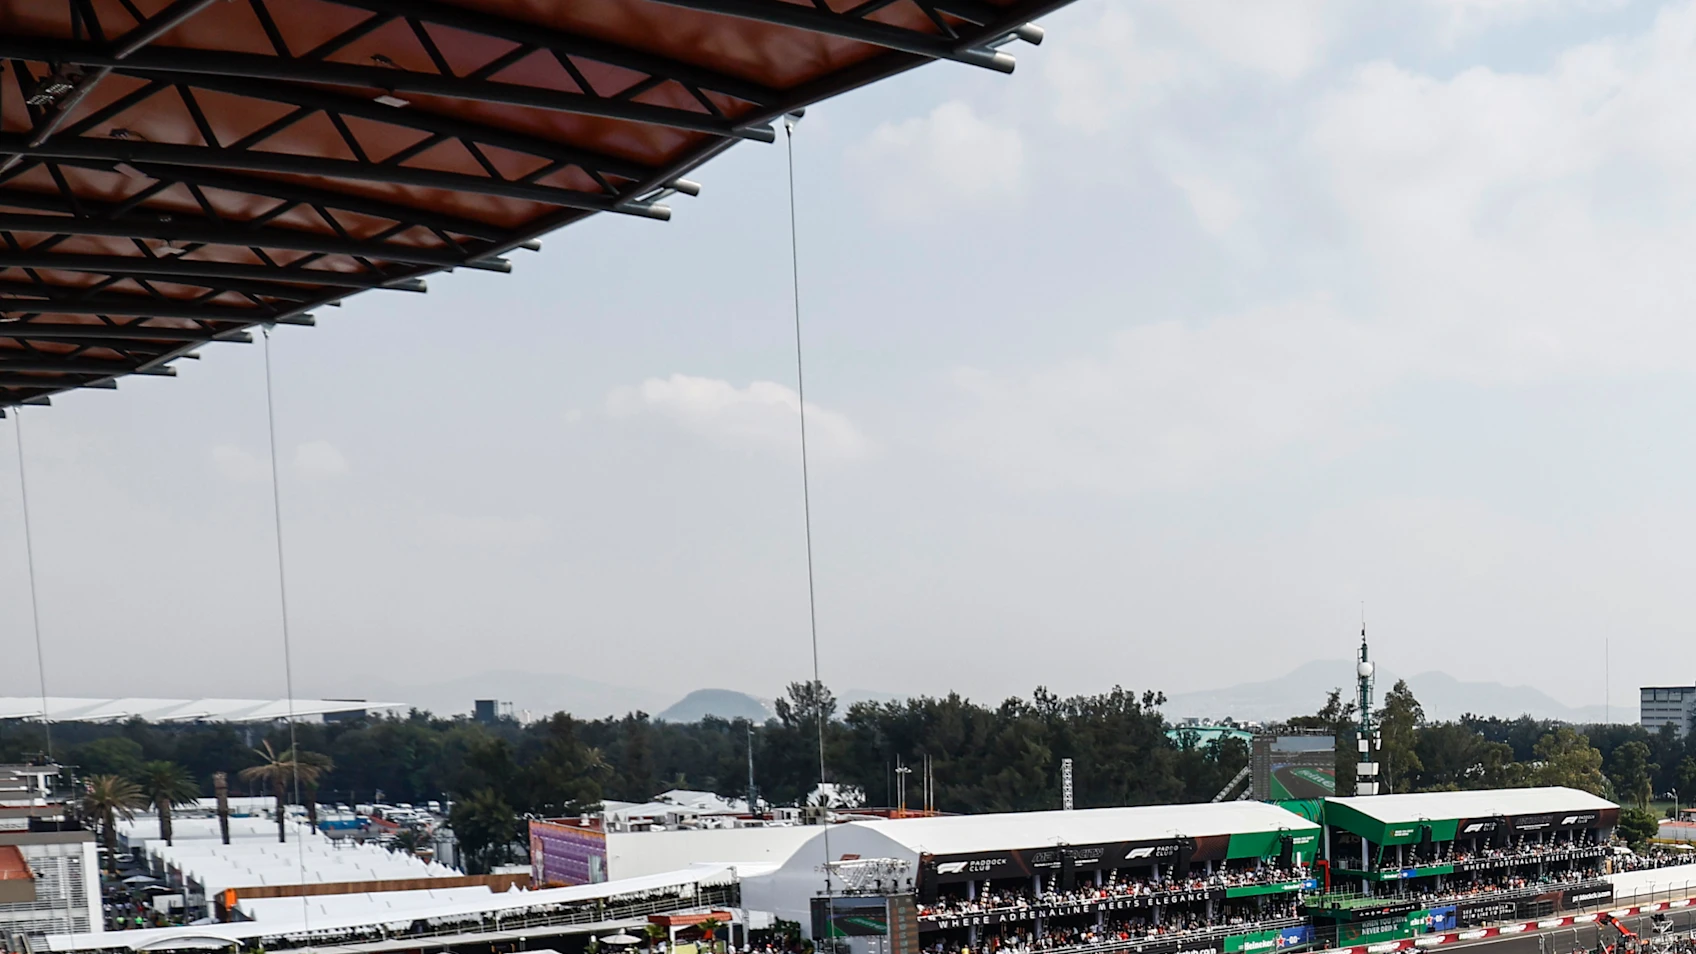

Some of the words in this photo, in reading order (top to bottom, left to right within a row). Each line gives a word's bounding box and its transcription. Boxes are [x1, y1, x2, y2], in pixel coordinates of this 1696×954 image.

[938, 916, 990, 929] WHERE
[999, 905, 1090, 922] ADRENALINE
[1098, 900, 1140, 911] MEETS
[1148, 892, 1210, 906] ELEGANCE
[1362, 927, 1379, 935] NEVER
